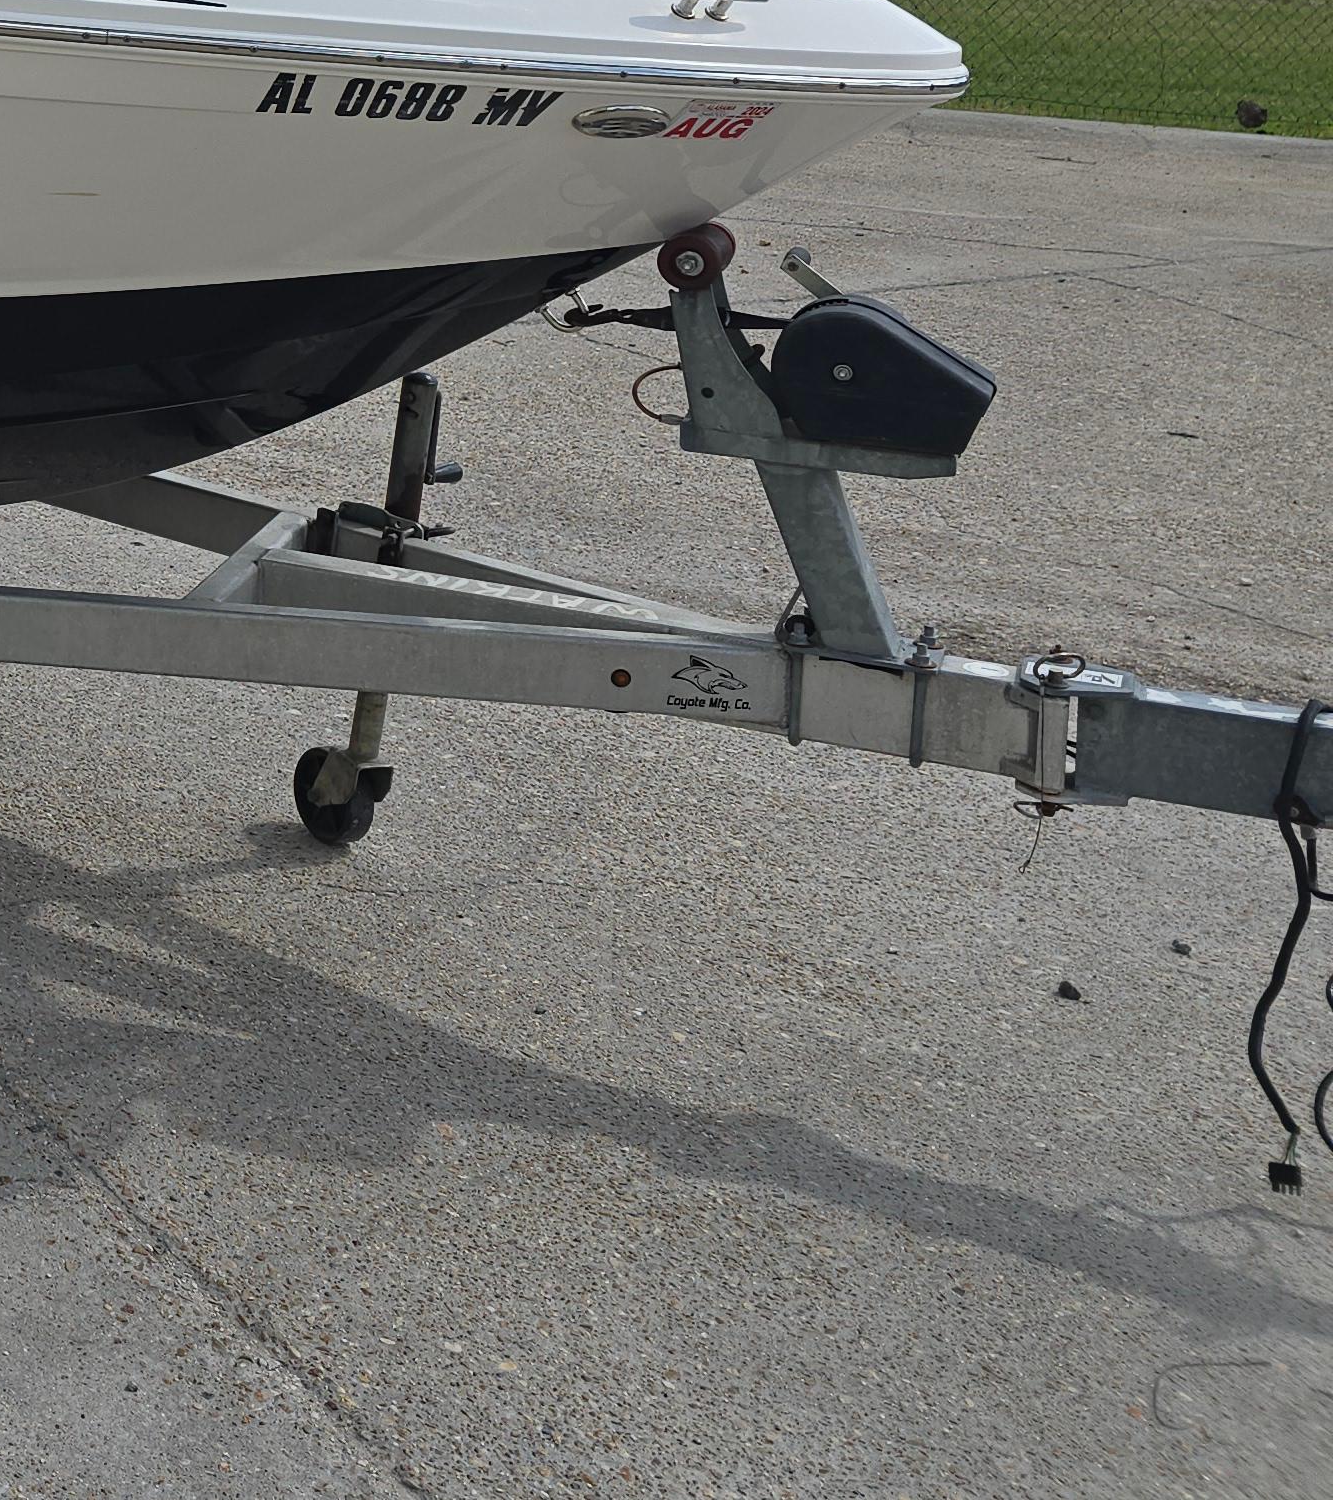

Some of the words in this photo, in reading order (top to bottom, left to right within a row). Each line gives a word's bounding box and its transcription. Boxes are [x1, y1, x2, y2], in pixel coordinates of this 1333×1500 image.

[255, 72, 314, 115] AL
[334, 77, 468, 122] 0688
[472, 87, 565, 127] MV
[662, 117, 754, 139] AUG
[666, 694, 706, 710] Coyote
[708, 697, 731, 712] Mfg.
[734, 698, 752, 711] Co.
